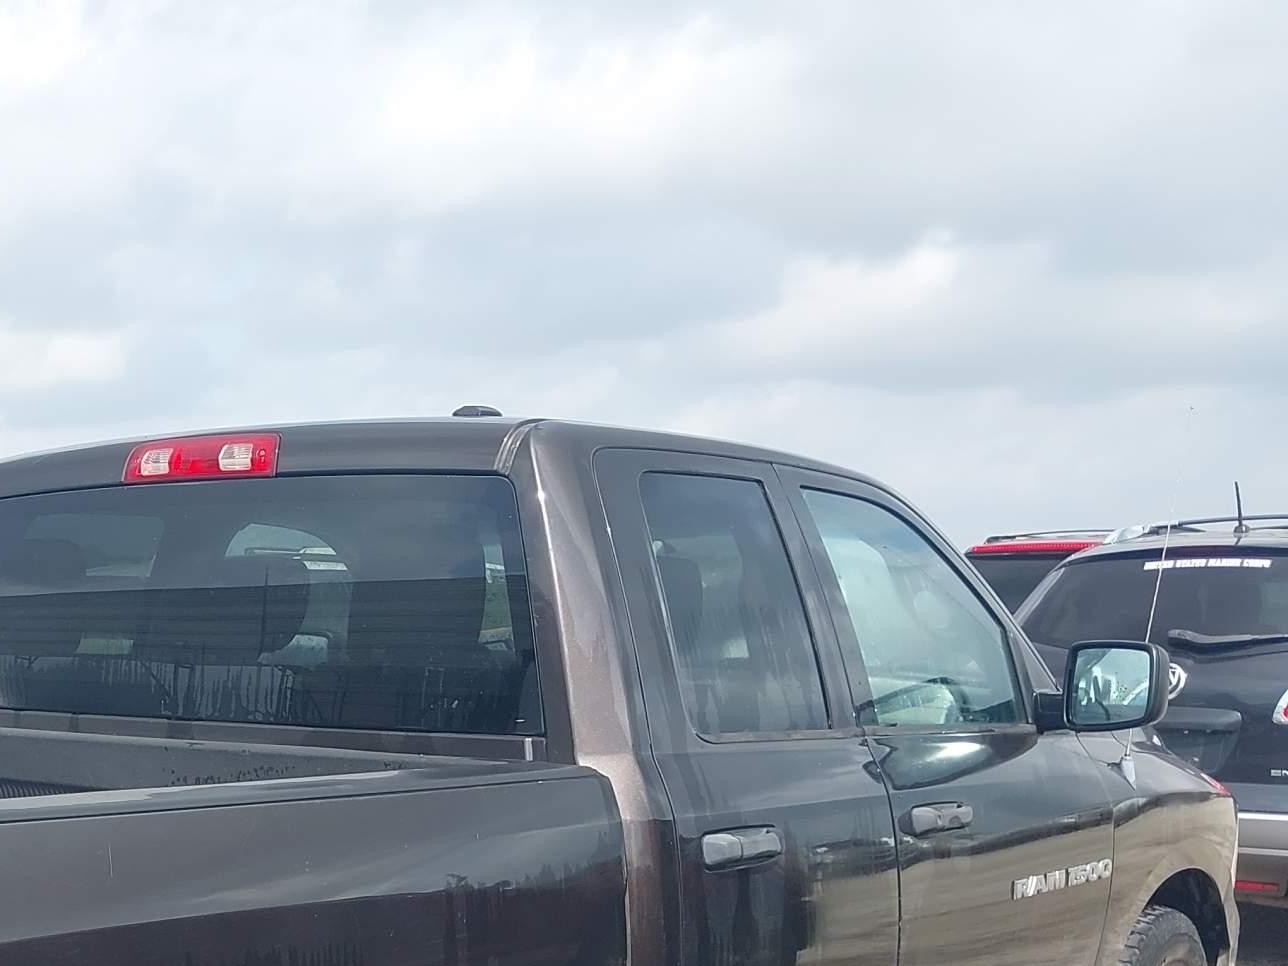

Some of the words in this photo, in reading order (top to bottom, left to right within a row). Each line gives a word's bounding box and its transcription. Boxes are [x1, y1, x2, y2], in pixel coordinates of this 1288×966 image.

[1175, 559, 1206, 568] STATES
[1207, 558, 1241, 567] MARINE
[1242, 558, 1272, 568] CORPS
[1012, 868, 1066, 901] RAM
[1067, 858, 1113, 888] 1500
